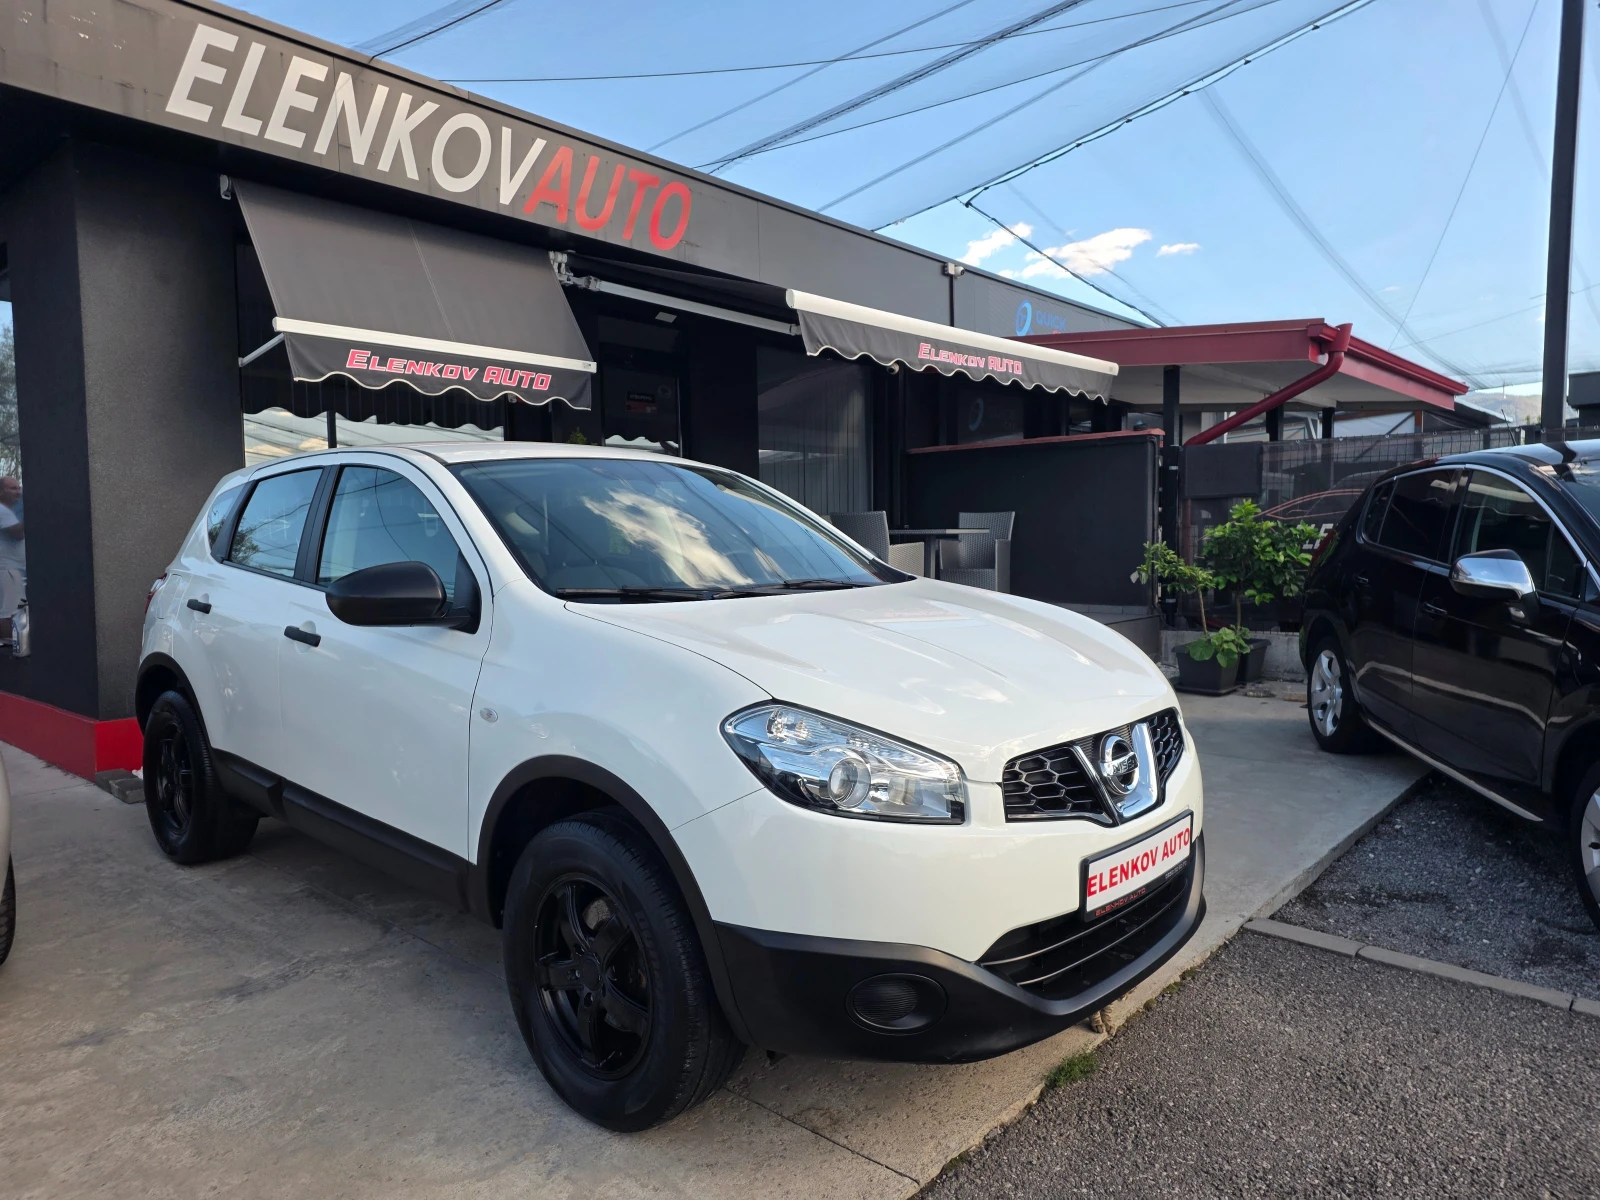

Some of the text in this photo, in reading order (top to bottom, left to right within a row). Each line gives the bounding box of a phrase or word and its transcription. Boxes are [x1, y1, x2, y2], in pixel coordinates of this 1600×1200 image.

[346, 348, 552, 391] ELENKOV AUTO
[917, 342, 1023, 375] ELENKOV AUTO
[1087, 845, 1159, 898] ELENKOV
[1161, 827, 1190, 862] AUTO
[1129, 887, 1147, 901] AUTO
